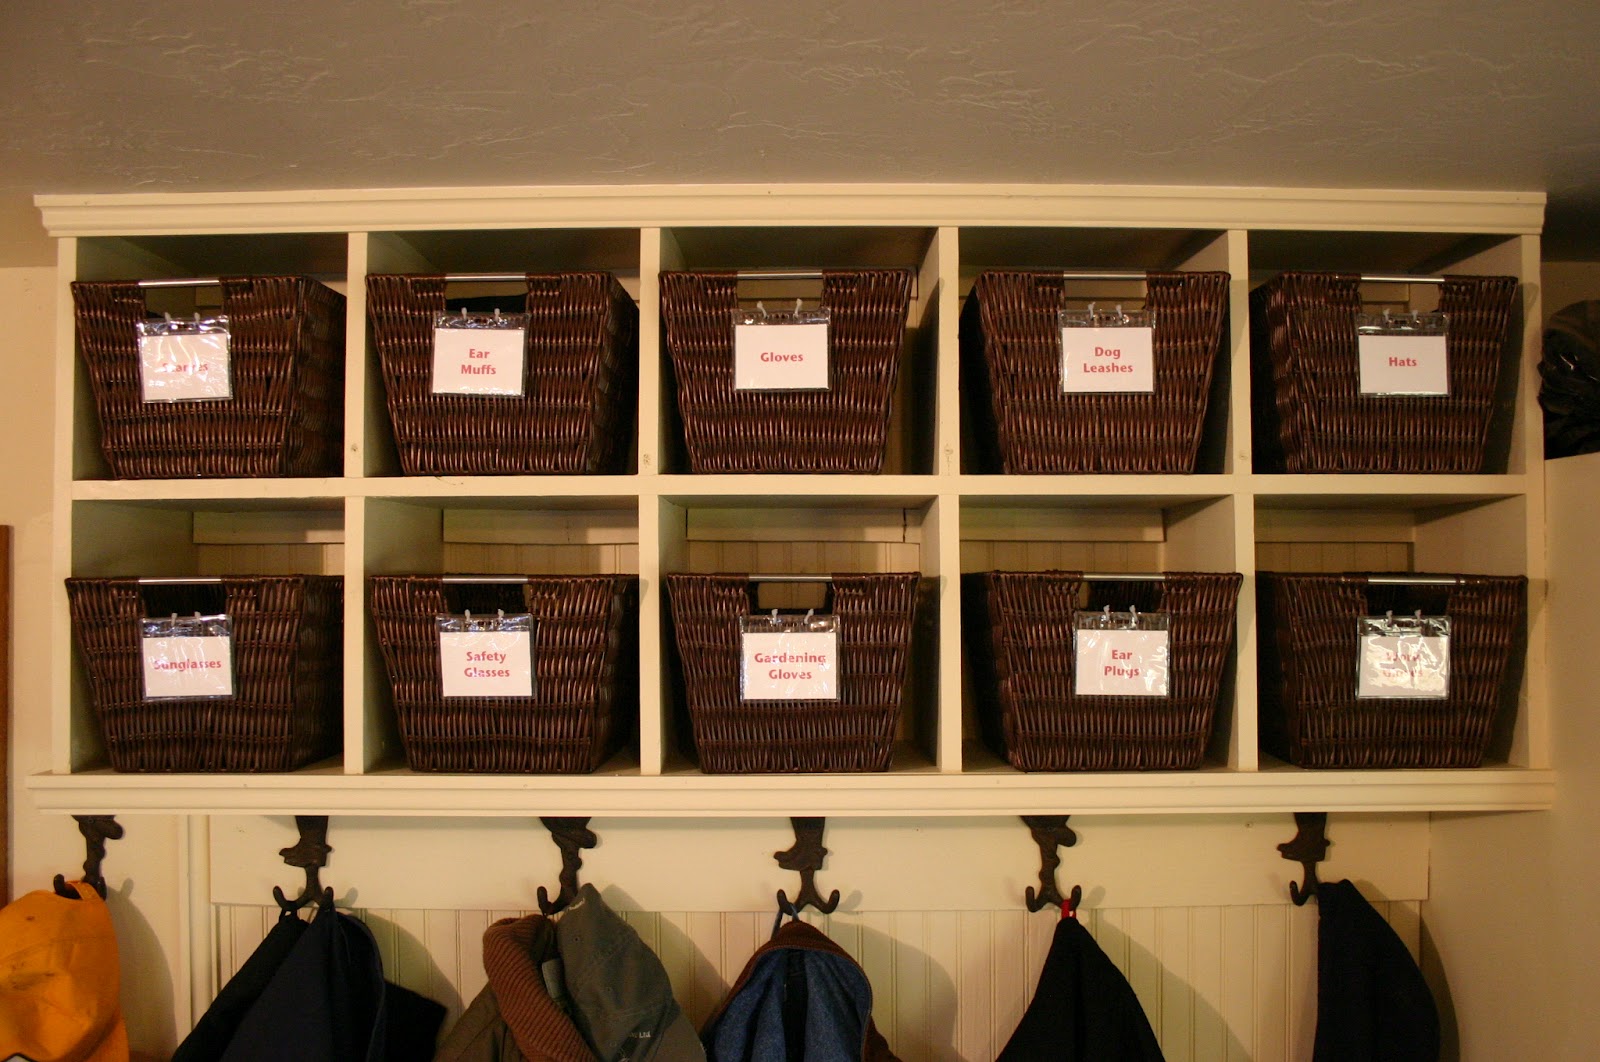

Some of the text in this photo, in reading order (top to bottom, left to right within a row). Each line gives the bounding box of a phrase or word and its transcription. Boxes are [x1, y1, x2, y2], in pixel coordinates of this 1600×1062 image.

[469, 348, 490, 358] Ear
[760, 352, 804, 362] Gloves
[1094, 346, 1120, 360] Dog
[1388, 356, 1418, 366] Hats
[461, 364, 496, 375] Muffs
[1083, 362, 1134, 372] Leashes
[466, 651, 506, 664] Safety
[754, 652, 826, 666] Gardening
[1112, 650, 1132, 660] Ear
[154, 658, 222, 672] Sunglasses
[464, 667, 510, 678] Glasses
[768, 669, 812, 680] Gloves
[1104, 666, 1140, 678] Plugs
